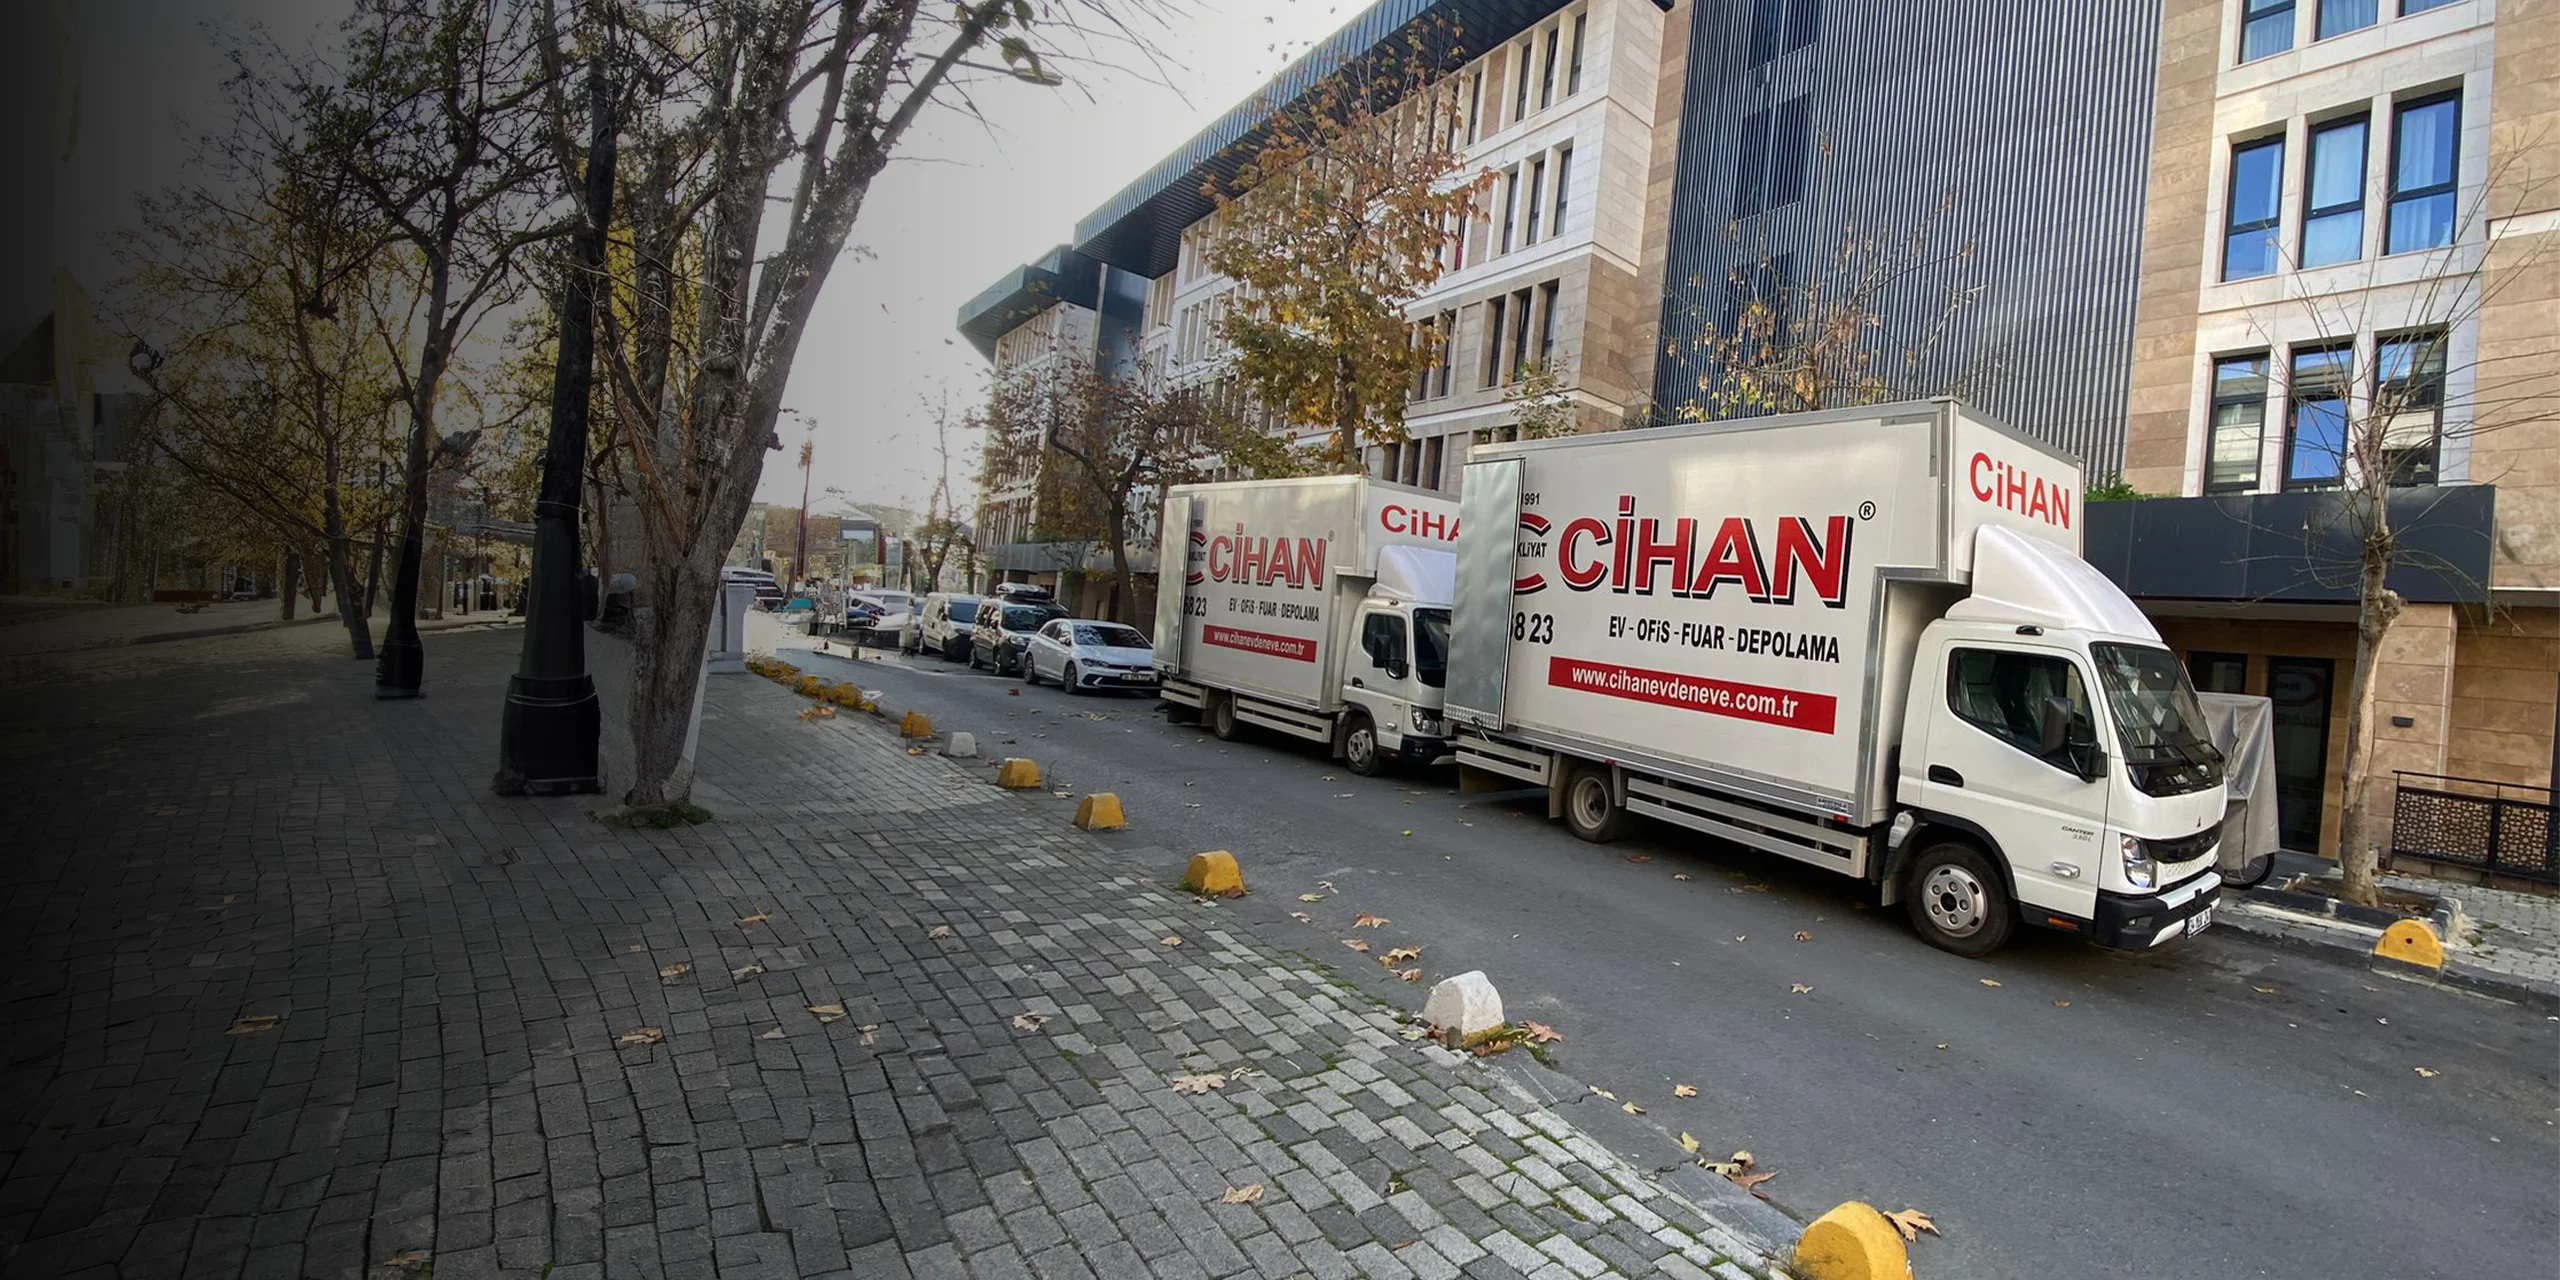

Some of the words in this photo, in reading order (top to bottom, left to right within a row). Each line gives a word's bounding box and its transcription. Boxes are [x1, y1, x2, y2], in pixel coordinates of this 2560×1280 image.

[1195, 596, 1207, 617] 23
[1259, 601, 1277, 617] FUAR
[1281, 603, 1320, 622] DEPOLAMA
[1529, 613, 1554, 644] 23
[1609, 616, 1627, 638] EV
[1681, 623, 1724, 650] FUAR
[1737, 628, 1840, 663] DEPOLAMA
[1213, 630, 1305, 656] www.cihanevdeneve.com.tr
[1572, 667, 1799, 719] www.cihanevdeneve.com.tr
